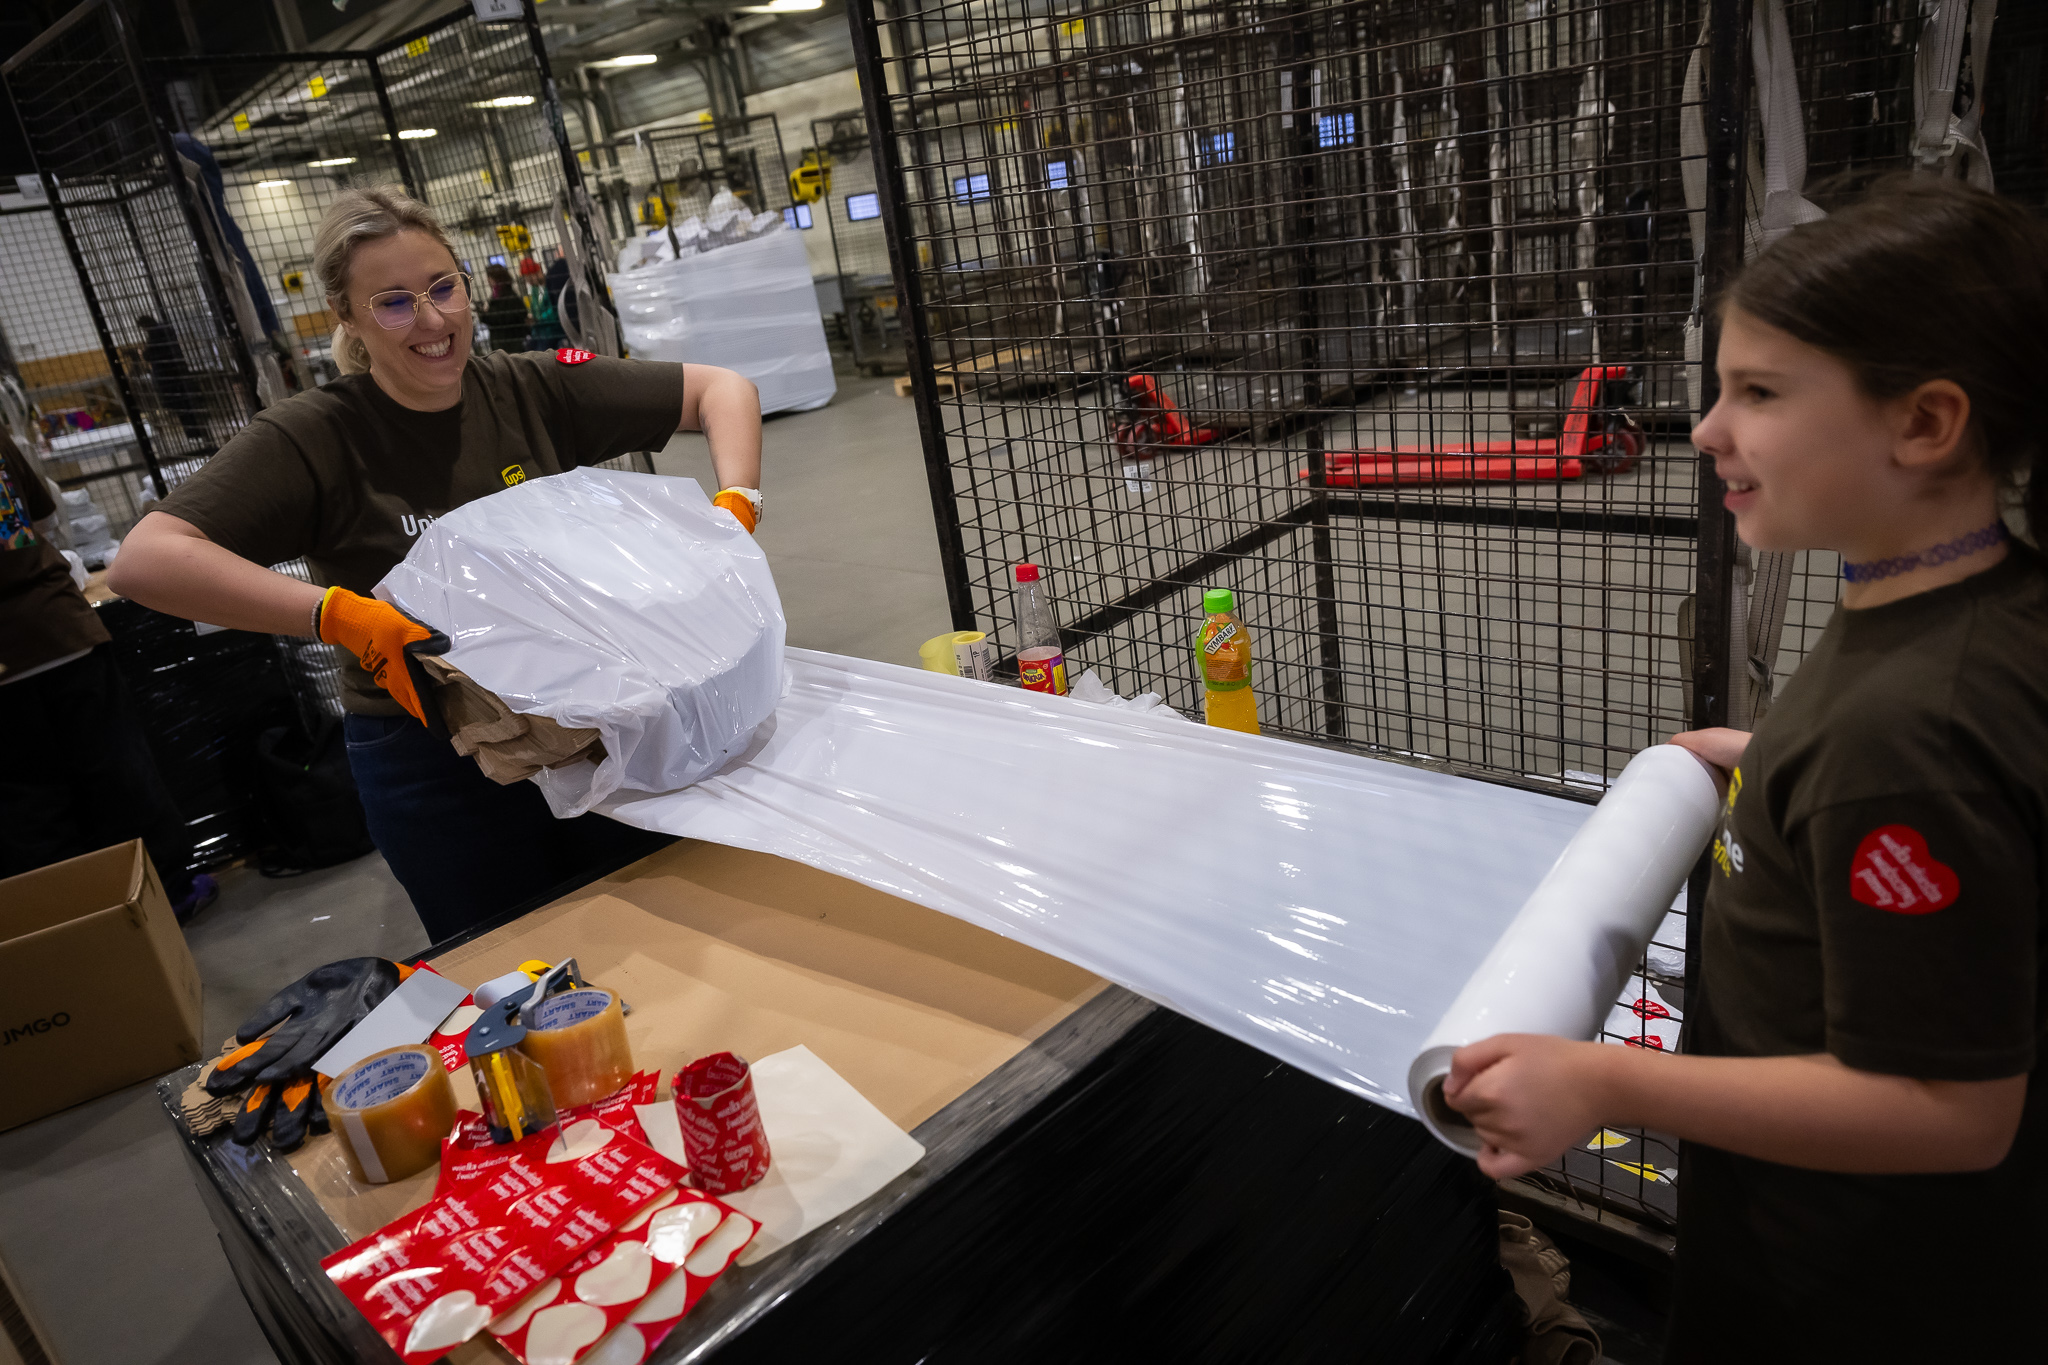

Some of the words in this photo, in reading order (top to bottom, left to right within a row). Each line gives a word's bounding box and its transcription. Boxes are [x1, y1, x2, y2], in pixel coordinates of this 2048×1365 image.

[504, 470, 524, 486] ups
[1206, 624, 1236, 652] TYMBARK
[542, 1001, 577, 1019] SMART
[585, 999, 609, 1008] MART
[3, 1012, 71, 1046] JMGO
[354, 1058, 389, 1081] SMART
[380, 1062, 416, 1078] SMART
[364, 1076, 400, 1099] SMART
